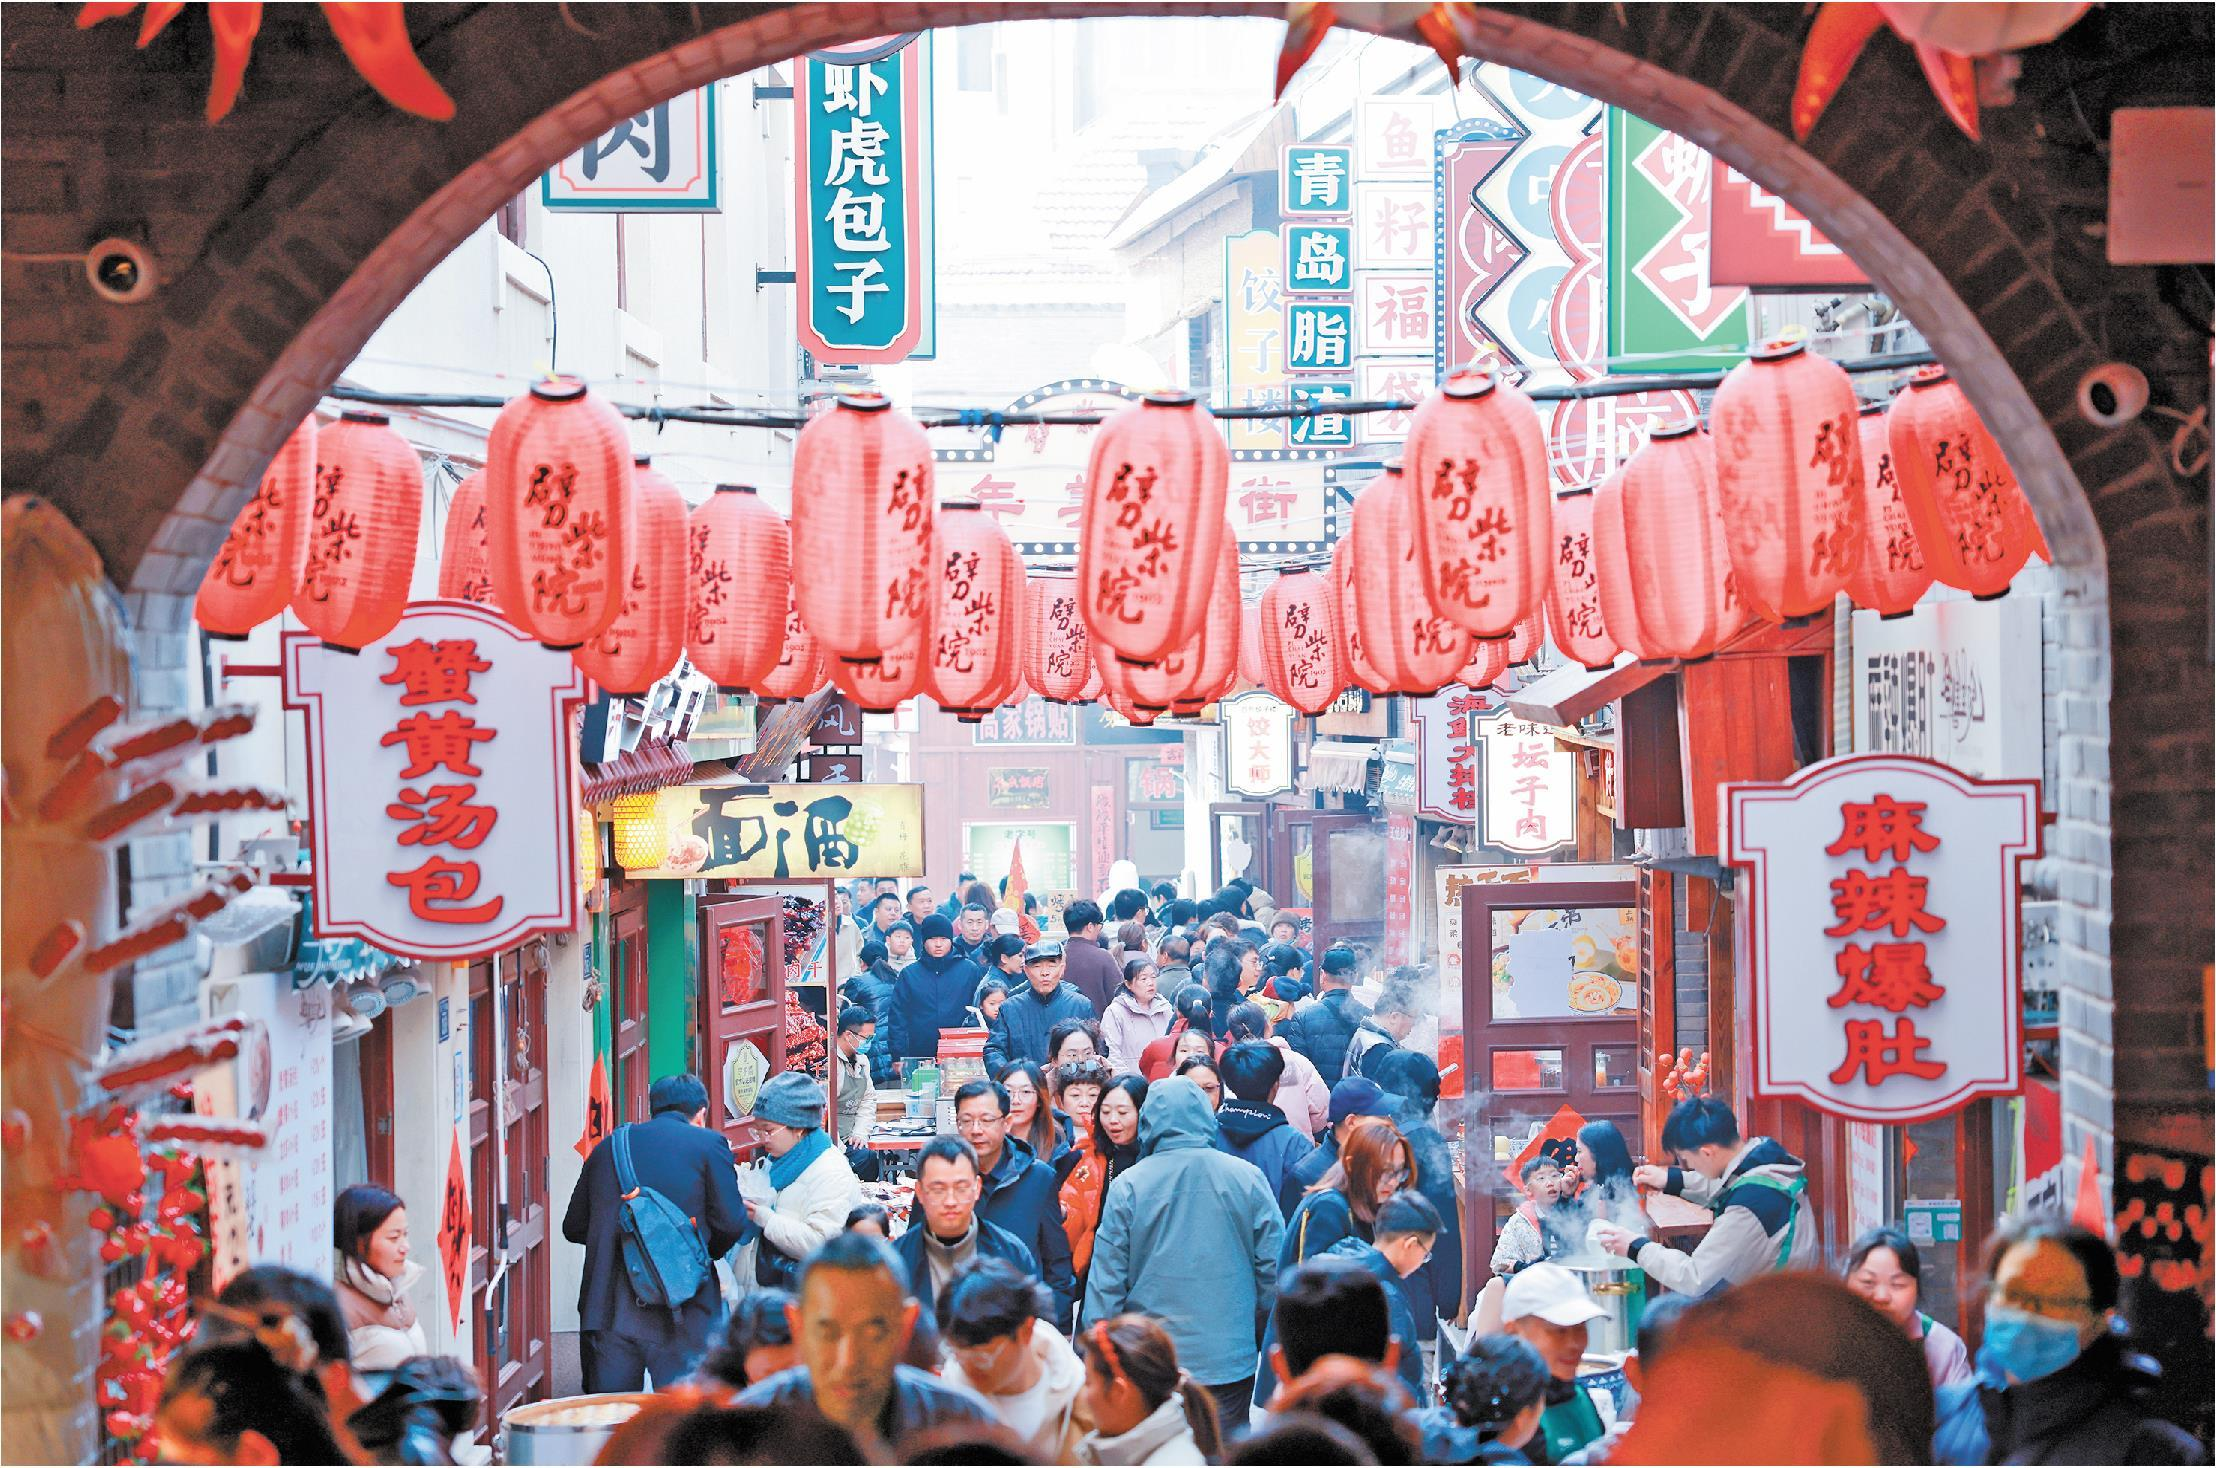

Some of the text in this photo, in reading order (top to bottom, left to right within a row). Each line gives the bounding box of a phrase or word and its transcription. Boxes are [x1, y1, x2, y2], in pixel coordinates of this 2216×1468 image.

[823, 61, 892, 325] 虾虎包子
[1292, 151, 1351, 443] 青岛脂渣
[527, 462, 608, 614] 劈柴院
[1096, 462, 1179, 625] 劈柴院
[1431, 458, 1513, 609] 劈柴院
[934, 551, 996, 673] 劈柴院
[1047, 597, 1086, 678] 劈柴院
[1283, 602, 1328, 689] 劈柴院
[379, 638, 504, 924] 蟹黄汤包
[1510, 741, 1551, 841] 坛子肉
[1824, 794, 1948, 1087] 麻辣爆肚
[1218, 1102, 1272, 1119] Champion
